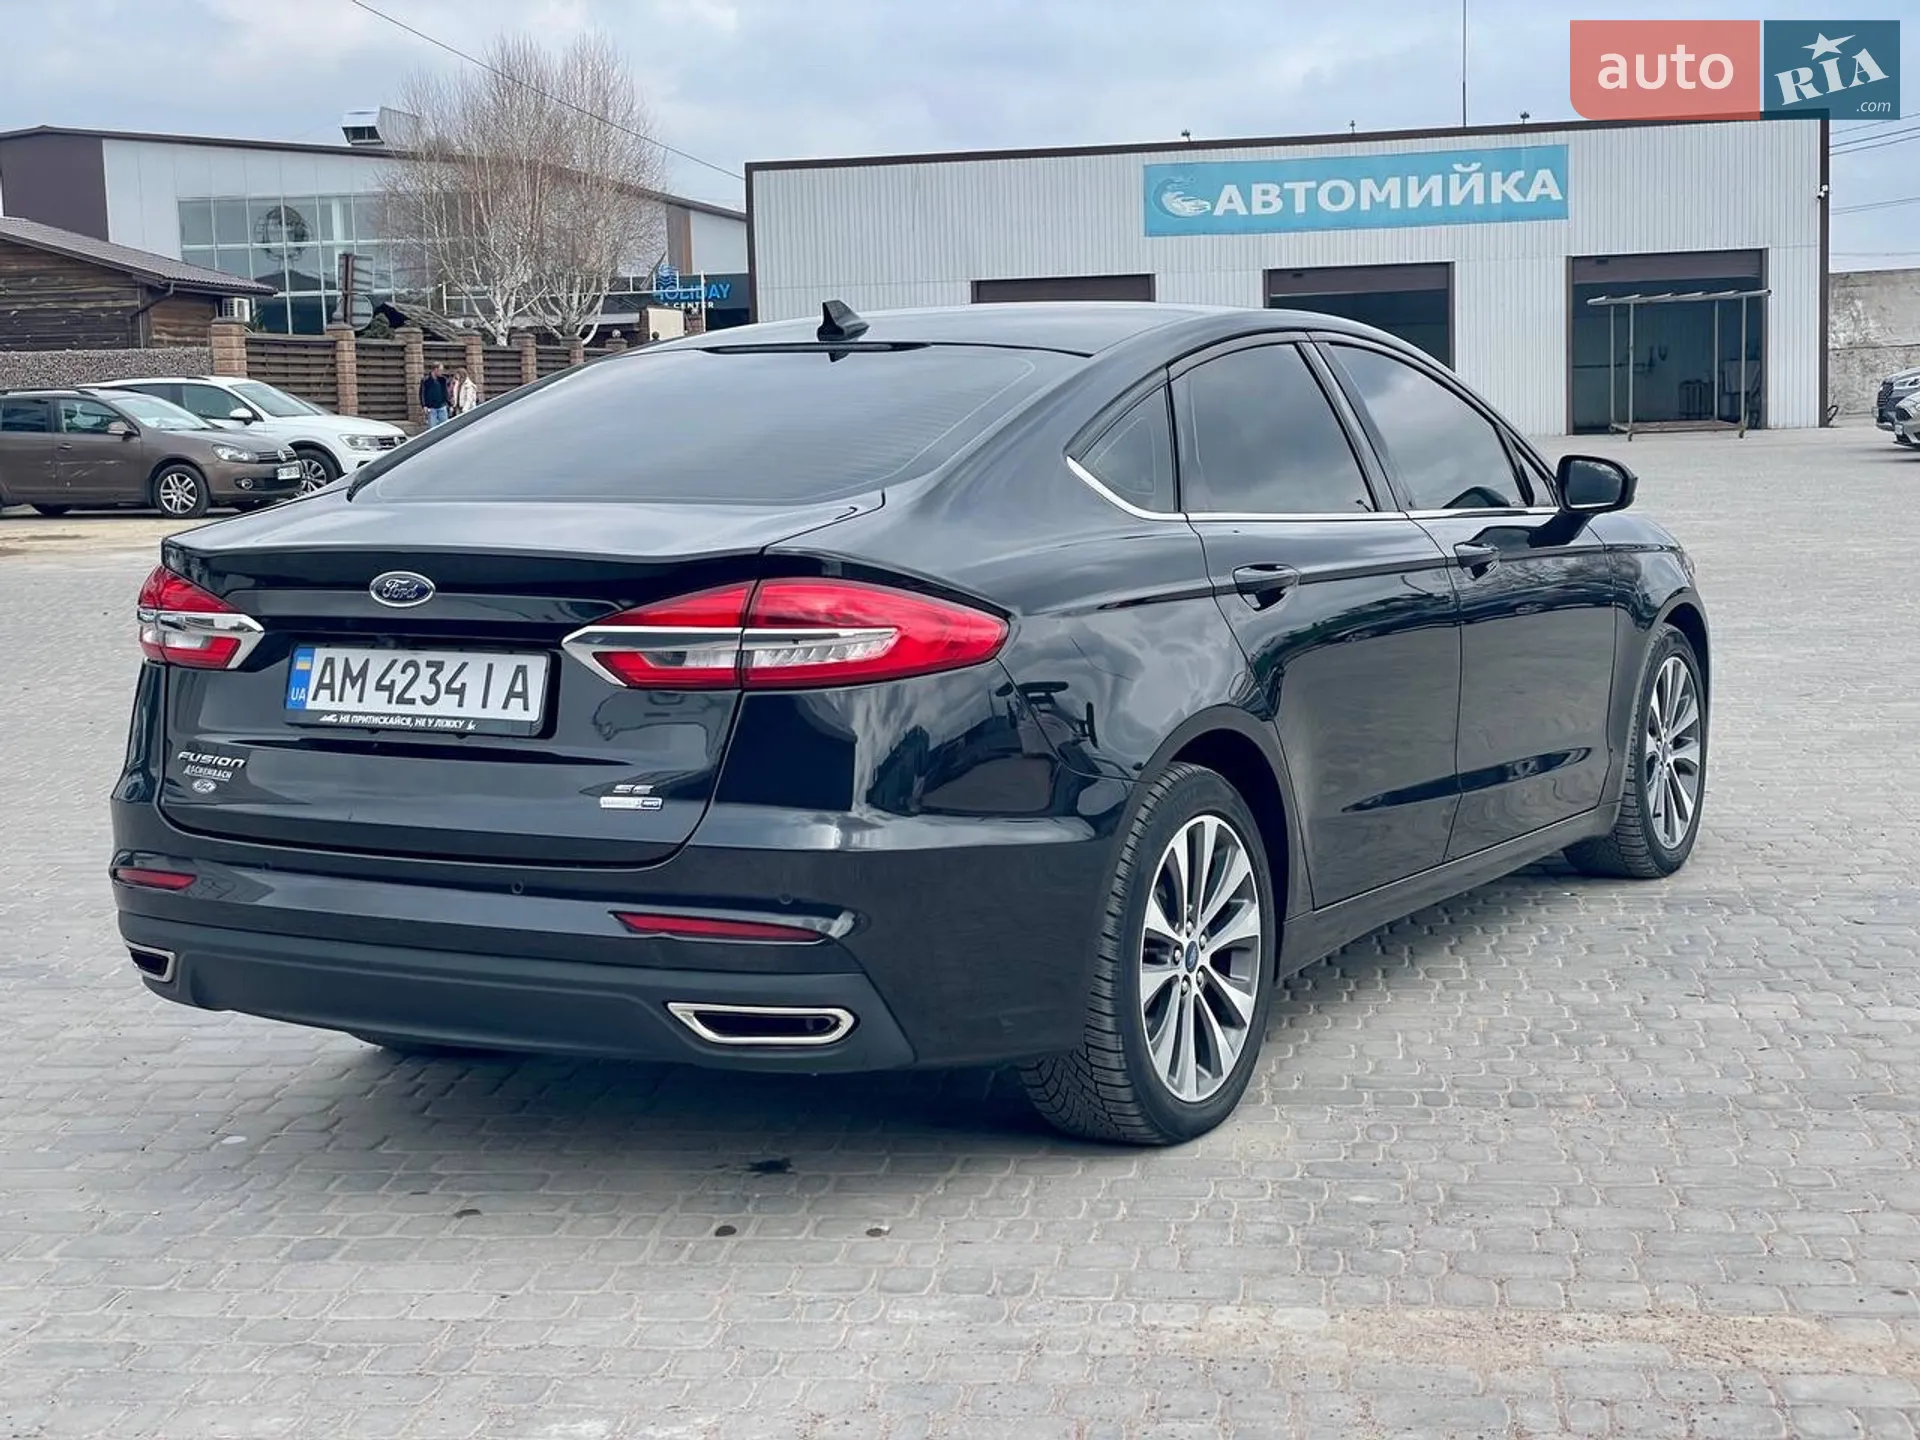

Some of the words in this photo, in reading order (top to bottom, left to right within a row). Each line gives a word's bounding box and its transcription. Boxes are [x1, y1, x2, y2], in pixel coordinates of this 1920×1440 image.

[1212, 162, 1563, 216] АВТОМИЙКА
[382, 578, 419, 599] Ford
[291, 686, 306, 701] UA
[311, 657, 371, 703] AM
[374, 658, 469, 708] 4234
[481, 663, 530, 711] IA
[177, 751, 246, 768] FUSION
